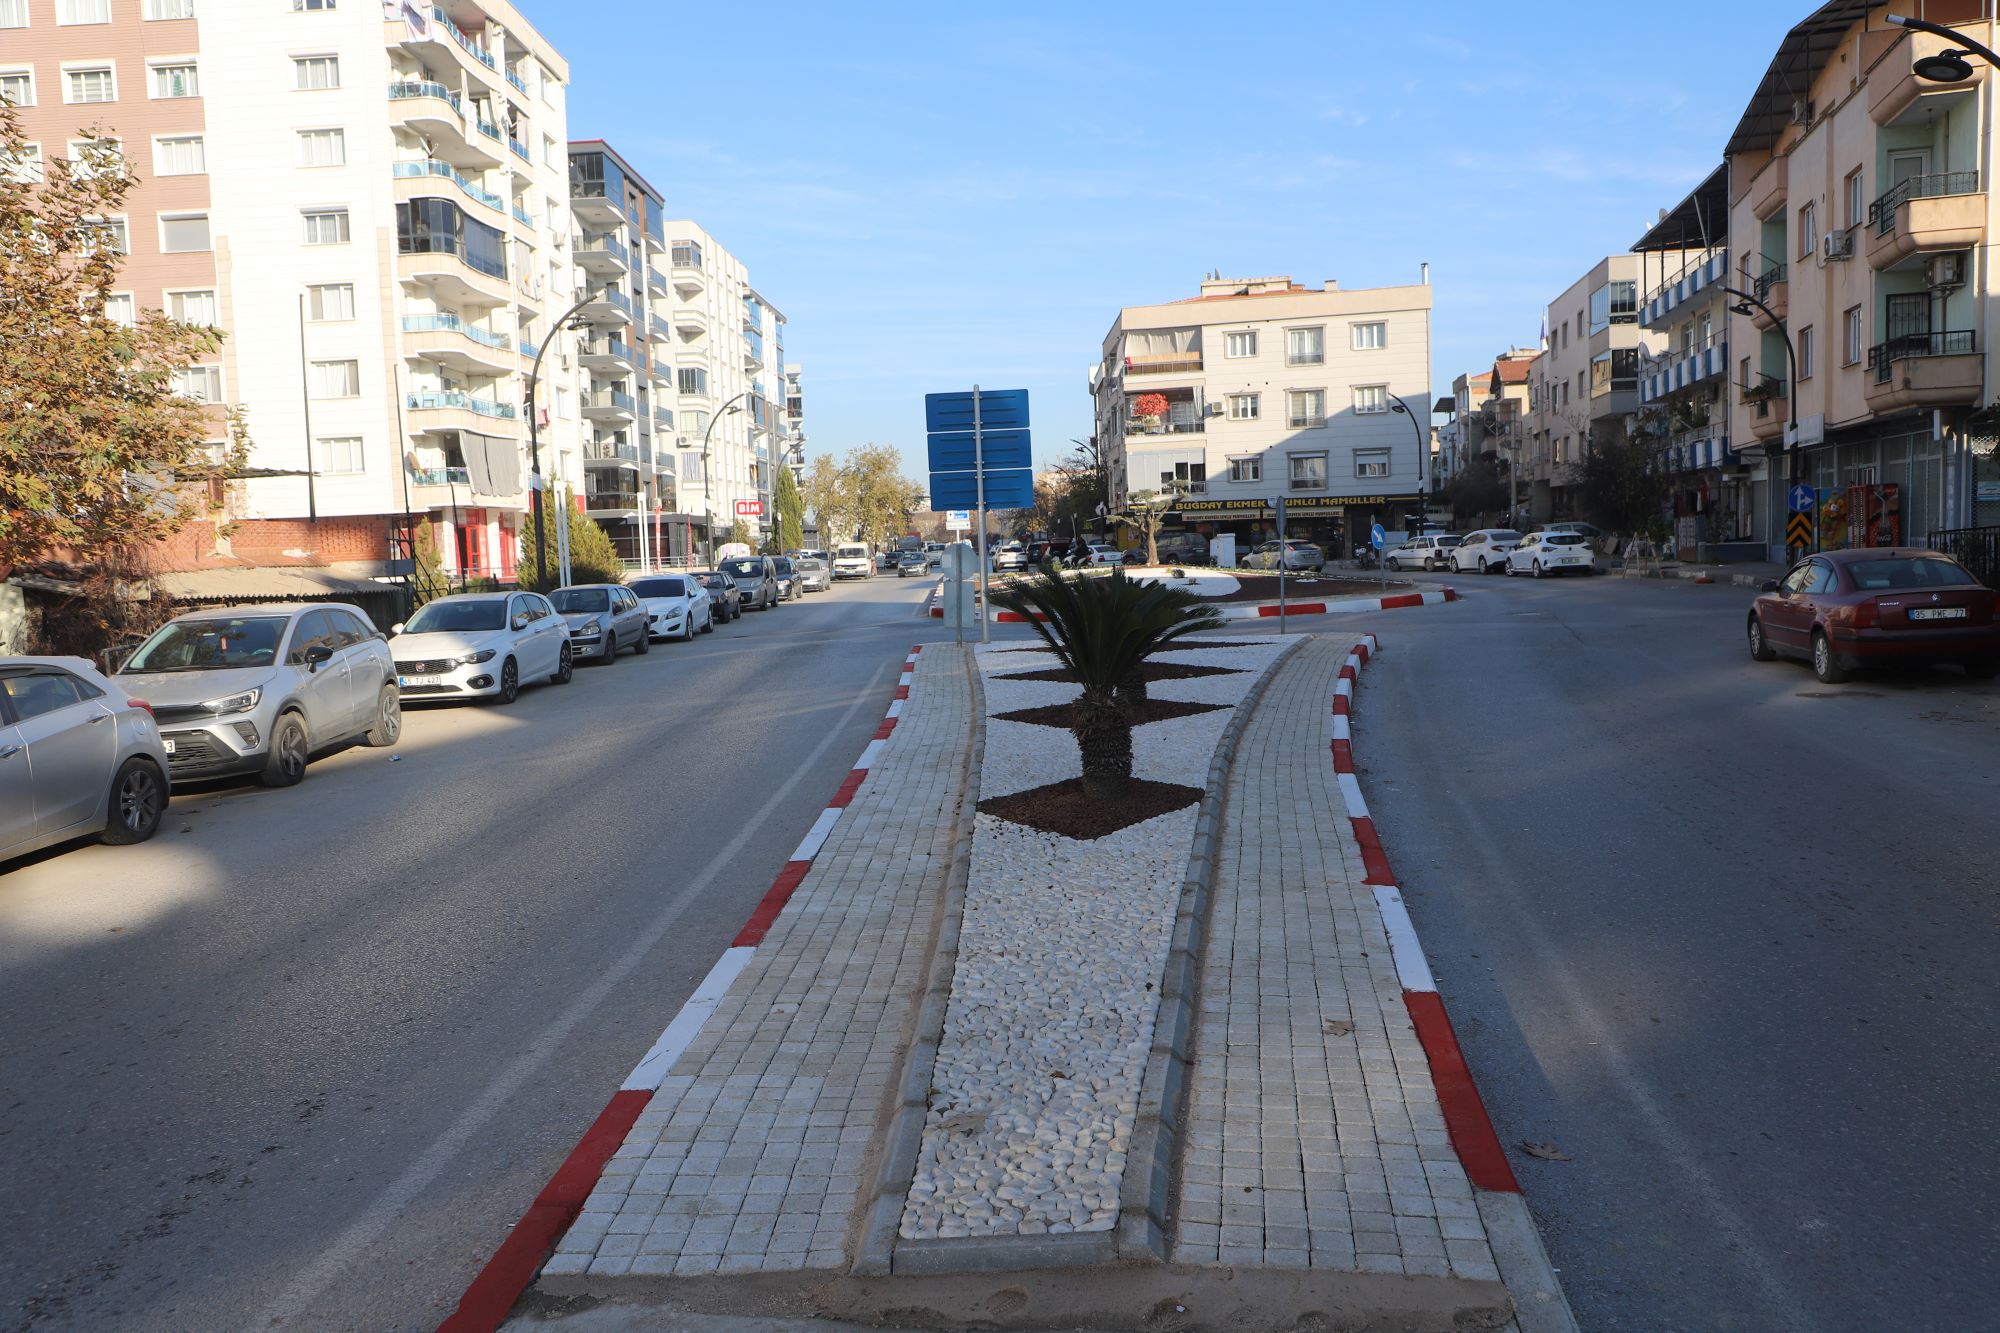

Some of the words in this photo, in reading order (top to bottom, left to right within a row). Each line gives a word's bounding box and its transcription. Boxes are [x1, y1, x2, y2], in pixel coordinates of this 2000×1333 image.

[1226, 500, 1266, 508] EKMEK
[1915, 610, 1926, 619] 35
[1932, 609, 1947, 618] PME
